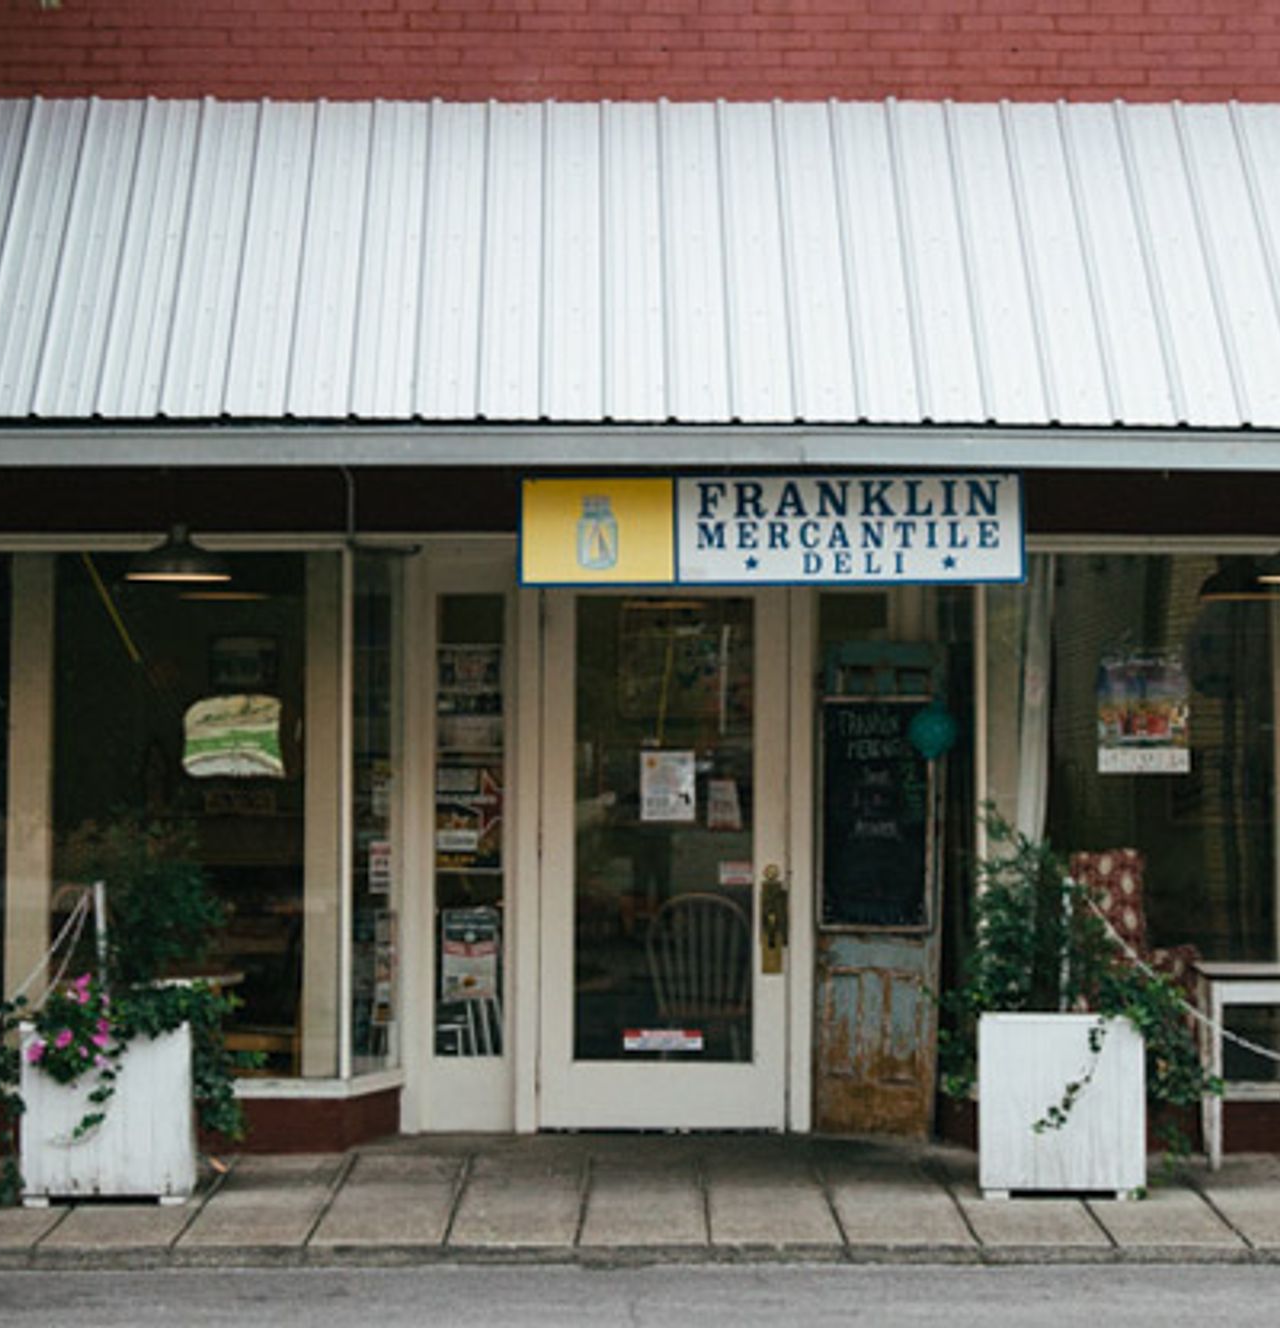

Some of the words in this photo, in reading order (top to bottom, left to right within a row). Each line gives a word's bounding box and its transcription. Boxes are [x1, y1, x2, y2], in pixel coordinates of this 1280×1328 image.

[696, 479, 1001, 519] FRANKLIN
[696, 520, 1001, 550] MERCANTILE
[802, 551, 906, 575] DELI
